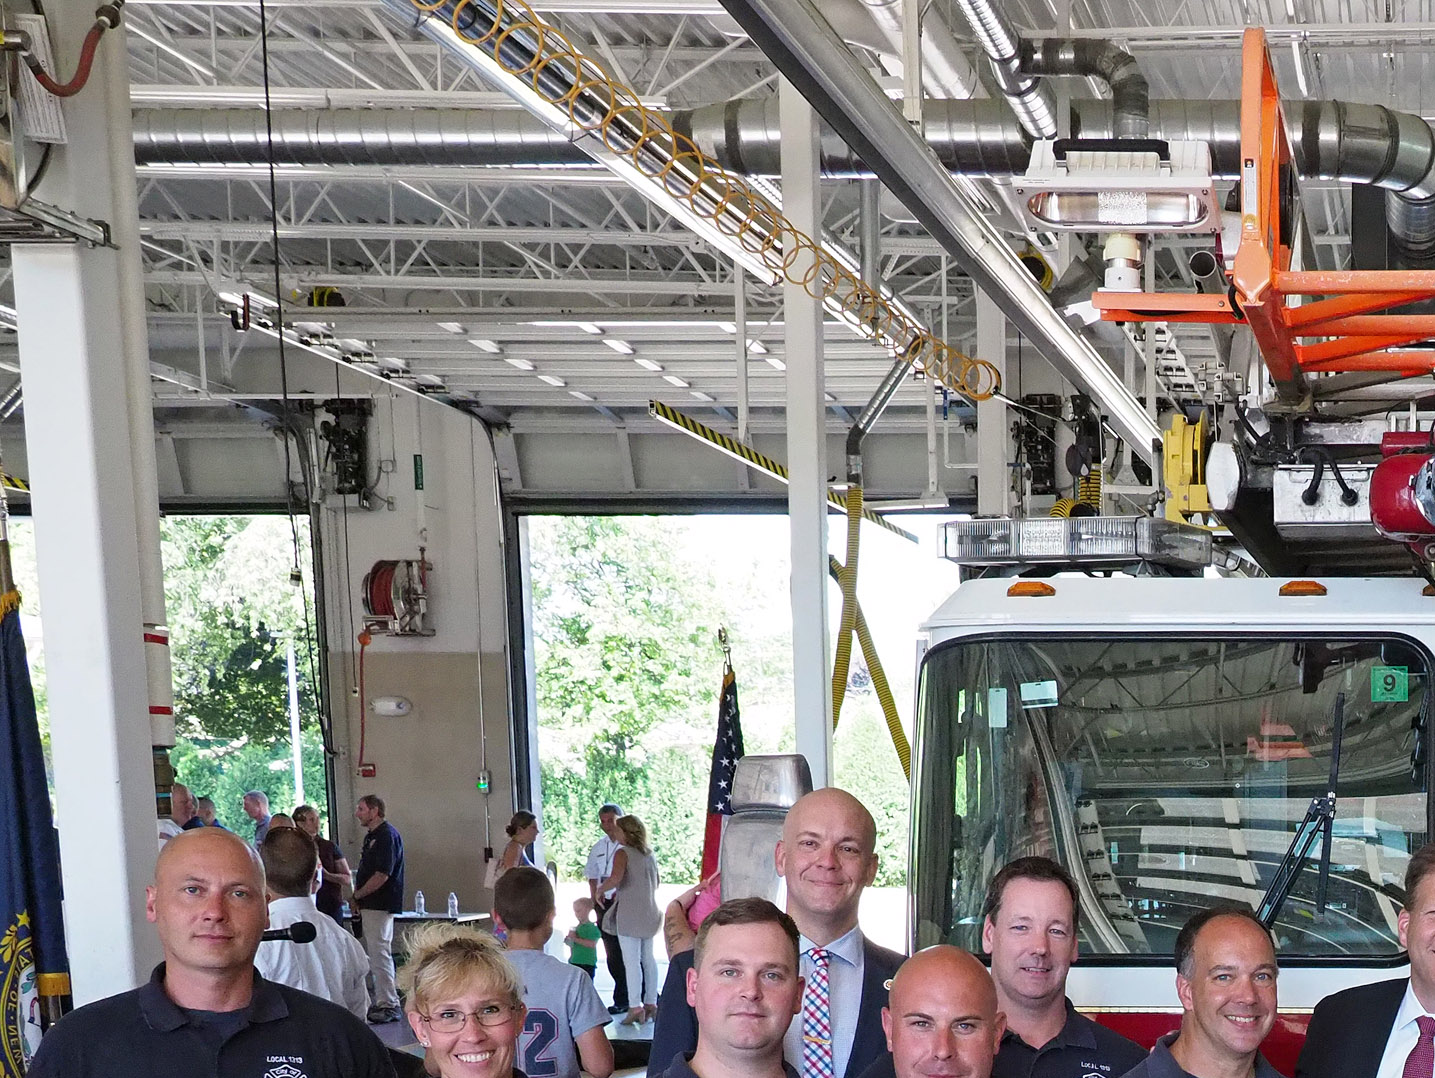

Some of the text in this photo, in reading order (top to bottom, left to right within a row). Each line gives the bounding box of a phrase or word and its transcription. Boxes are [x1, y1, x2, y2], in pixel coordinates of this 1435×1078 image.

[1384, 674, 1396, 692] 9
[515, 1008, 559, 1078] 2
[267, 1055, 288, 1063] LOCAL
